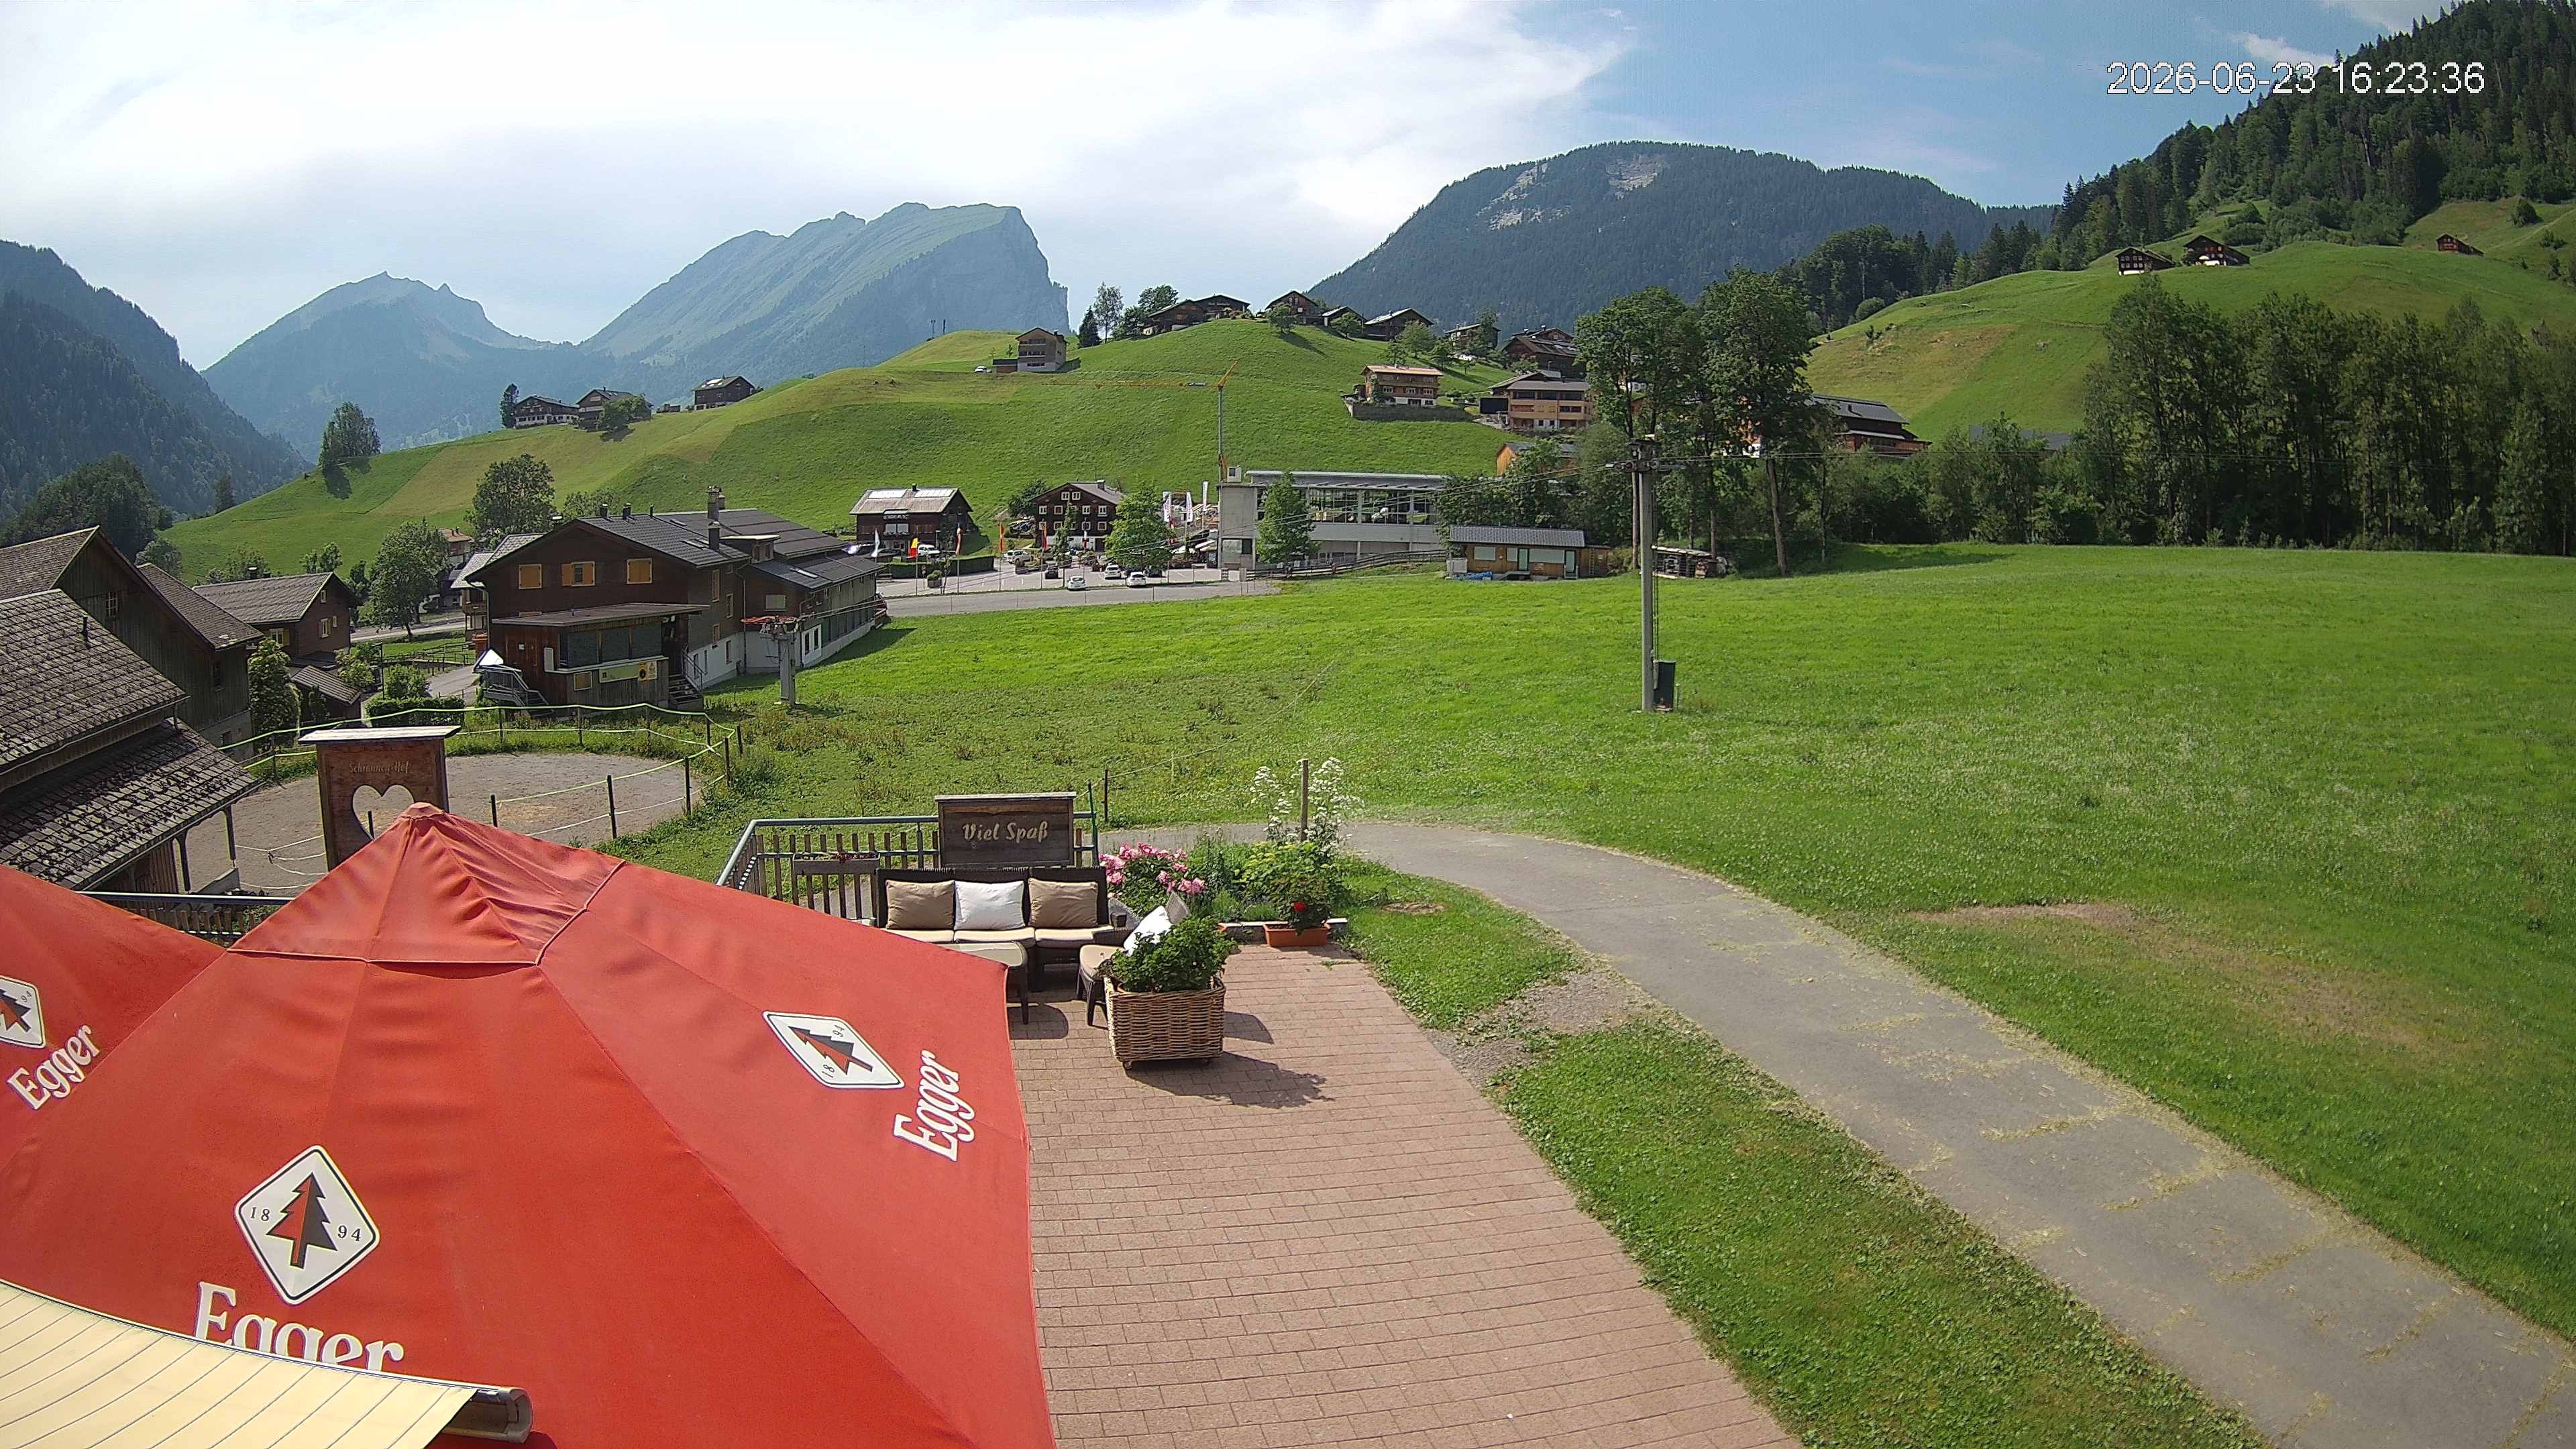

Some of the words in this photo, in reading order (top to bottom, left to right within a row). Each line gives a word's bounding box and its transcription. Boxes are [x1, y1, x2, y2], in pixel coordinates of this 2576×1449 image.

[962, 822, 1000, 841] Viel
[1006, 820, 1048, 844] Spaß
[7, 1025, 101, 1110] Egger
[893, 1049, 975, 1162] Egger
